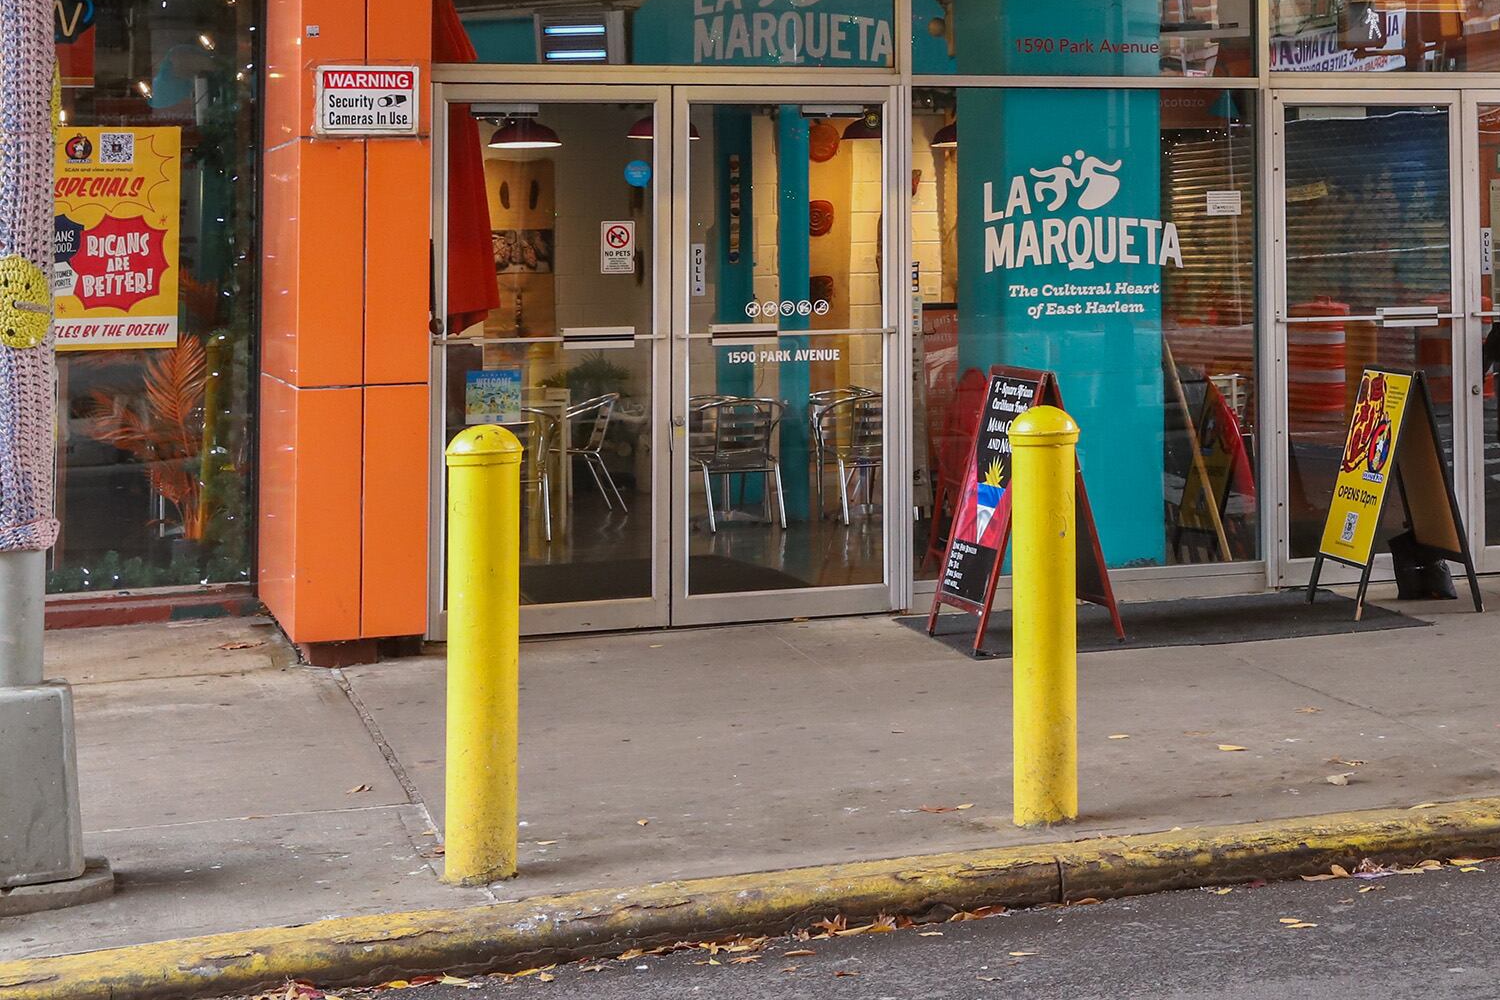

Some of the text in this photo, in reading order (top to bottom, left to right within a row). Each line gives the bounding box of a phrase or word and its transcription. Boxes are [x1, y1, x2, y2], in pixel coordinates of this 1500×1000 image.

[693, 11, 895, 65] MARQUETA
[1016, 38, 1159, 54] 1590 Park Avenue
[328, 73, 409, 88] WARNING
[329, 94, 374, 110] Security
[329, 111, 408, 125] Cameras In Use
[54, 176, 144, 199] SPECIALS
[983, 175, 1032, 223] LA
[86, 232, 150, 257] RICANS
[984, 215, 1184, 274] MARQUETA
[106, 256, 130, 273] ARE
[82, 268, 154, 298] BETTER!
[1008, 282, 1160, 298] The Cultural Heart
[1027, 300, 1145, 319] of East Harlem
[86, 325, 99, 338] BY
[102, 324, 126, 338] THE
[127, 323, 170, 337] DOZEN!
[727, 349, 840, 364] 1590 PARK AVENUE
[1337, 485, 1378, 508] OPENS 12pm
